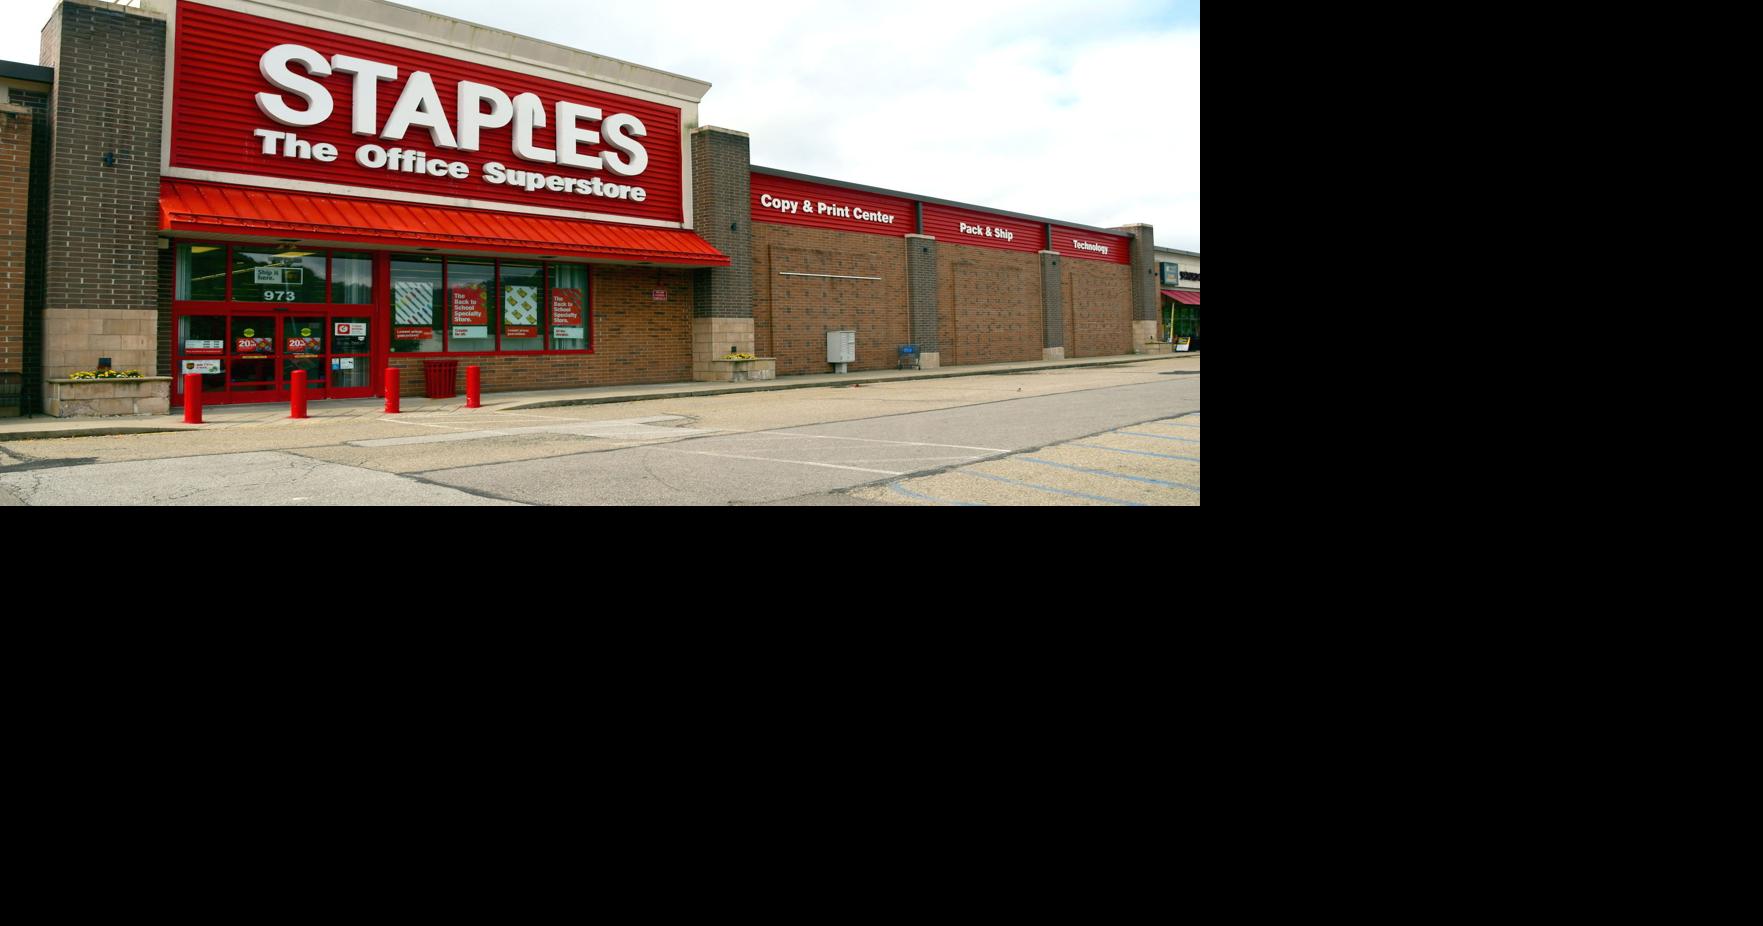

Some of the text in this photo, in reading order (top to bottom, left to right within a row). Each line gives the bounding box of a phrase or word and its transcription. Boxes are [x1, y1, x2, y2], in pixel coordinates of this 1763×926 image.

[255, 43, 649, 176] STAPLES
[254, 128, 647, 202] The Office Superstore
[760, 193, 895, 224] Copy & Print Center
[959, 221, 1014, 241] Pack & Ship
[1072, 239, 1109, 255] Technology
[263, 290, 296, 302] 973
